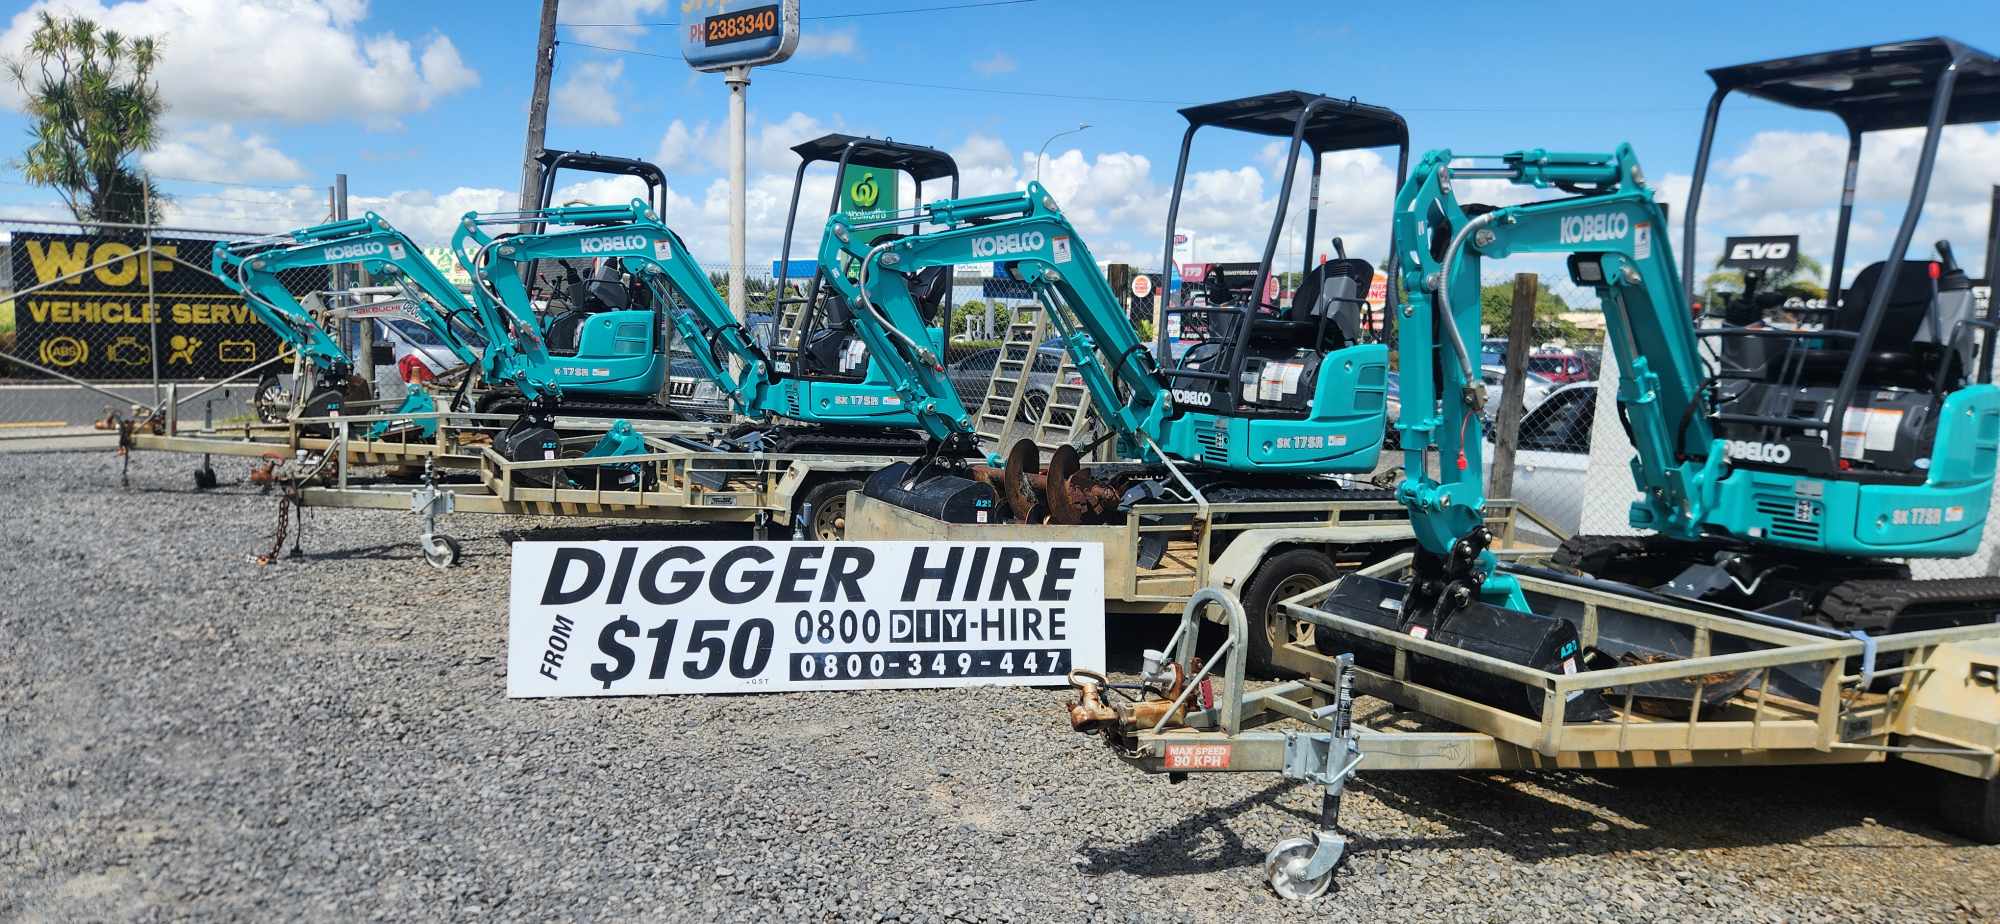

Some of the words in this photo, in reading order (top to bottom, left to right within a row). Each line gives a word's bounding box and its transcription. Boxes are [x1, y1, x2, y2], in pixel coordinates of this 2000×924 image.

[709, 10, 775, 40] 2383340
[1560, 212, 1629, 244] KOBELCO
[324, 242, 383, 260] KOBELCO
[581, 235, 647, 253] KOBELCO
[972, 231, 1045, 257] KOBELCO
[1730, 242, 1791, 260] EVO
[25, 240, 177, 287] WOF
[28, 301, 162, 325] VEHICLE
[171, 303, 258, 325] SERVI
[53, 346, 77, 356] ABS
[1277, 437, 1291, 449] SK
[1294, 435, 1323, 449] 17SR
[1892, 509, 1909, 525] SK
[1911, 508, 1942, 525] 17SR
[540, 545, 875, 606] DIGGER
[900, 547, 1082, 602] HIRE
[795, 609, 881, 644] 0800
[889, 607, 1066, 643] DIY-HIRE
[539, 614, 575, 681] FROM
[590, 614, 775, 690] $150
[800, 651, 1061, 679] 0800-349-447
[1170, 746, 1192, 756] MAX
[1195, 746, 1227, 756] SPEED
[1174, 755, 1190, 767] 90
[1195, 755, 1221, 767] KPH
